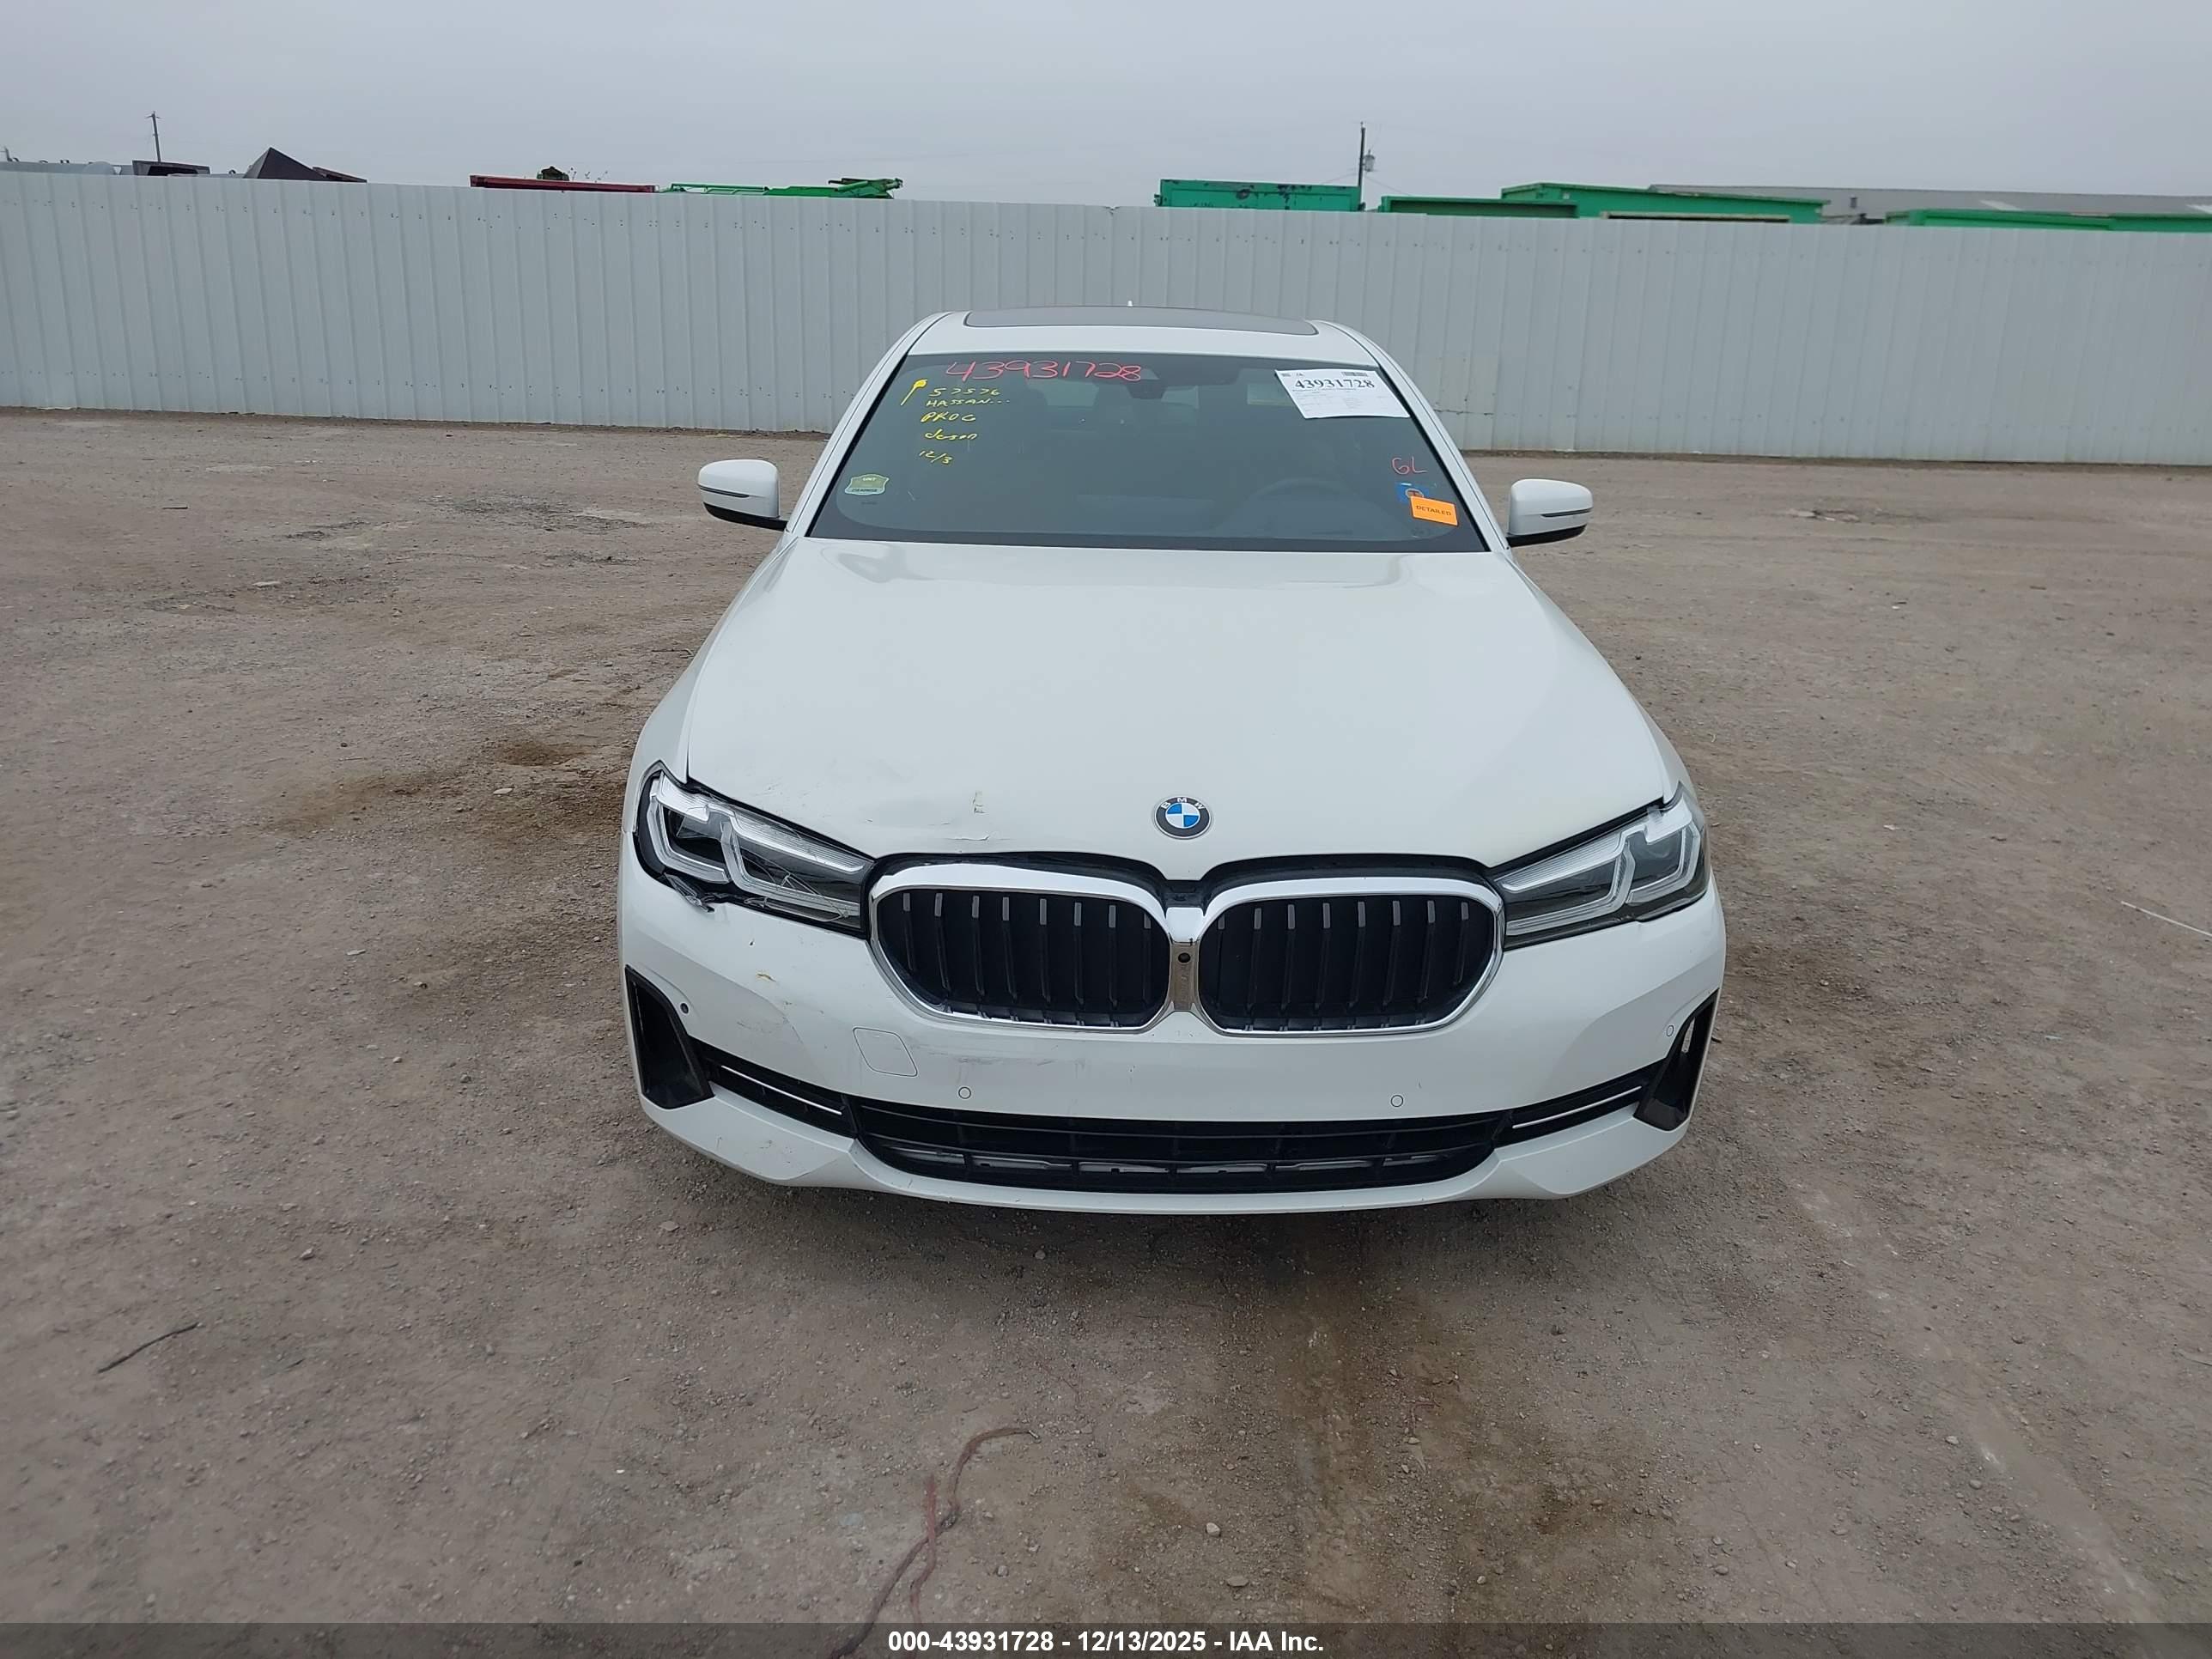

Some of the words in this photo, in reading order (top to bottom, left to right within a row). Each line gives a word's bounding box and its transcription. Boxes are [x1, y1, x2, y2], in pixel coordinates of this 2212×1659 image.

[945, 360, 1142, 382] 43931728
[1295, 379, 1375, 389] 43931728
[1415, 505, 1451, 517] DETAILED
[1160, 797, 1205, 810] BMW
